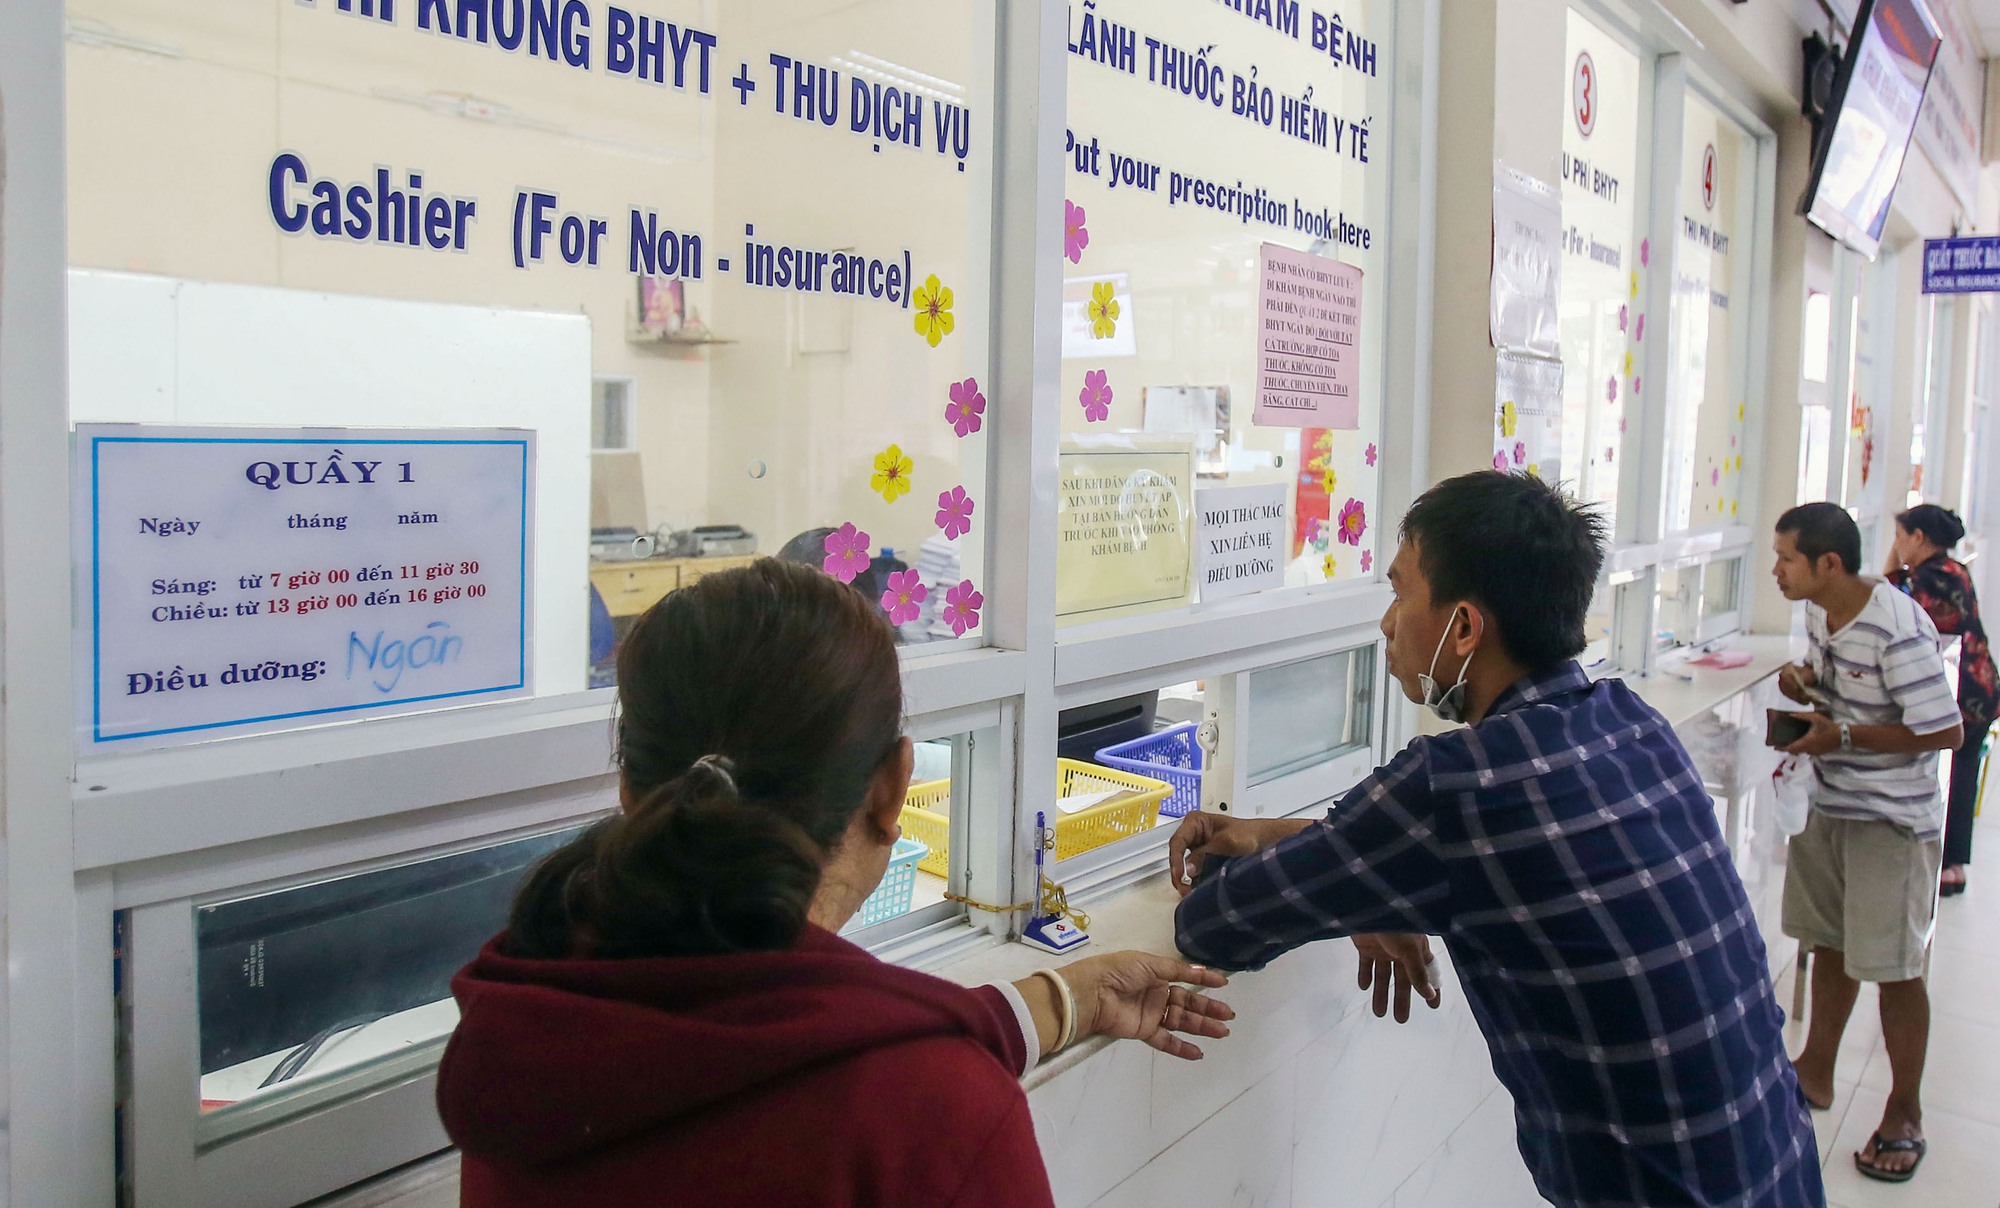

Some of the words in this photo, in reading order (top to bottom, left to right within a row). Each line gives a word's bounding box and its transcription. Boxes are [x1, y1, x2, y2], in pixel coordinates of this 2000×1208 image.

[1312, 11, 1376, 77] BỆNH
[608, 6, 717, 93] BHYT
[733, 64, 755, 105] +
[770, 53, 838, 126] THU
[851, 77, 922, 153] DỊCH
[934, 100, 969, 172] VỤ
[1068, 0, 1136, 75] LÃNH
[1145, 37, 1224, 107] THUỐC
[1232, 65, 1273, 127] BẢO
[1281, 86, 1327, 148] HIỂM
[1334, 116, 1344, 153] Y
[1350, 116, 1372, 164] TẾ
[1580, 64, 1591, 125] 3
[1573, 157, 1590, 191] PHÍ
[1593, 167, 1619, 204] BHYT
[1705, 155, 1712, 202] 4
[1109, 153, 1160, 192] your
[1170, 171, 1288, 227] prescription
[1294, 199, 1335, 240] book
[1338, 213, 1371, 250] here
[269, 153, 475, 249] Cashier
[513, 192, 606, 268] (For
[630, 209, 701, 279] Non
[746, 223, 911, 309] insurance)
[1684, 216, 1697, 241] THU
[1712, 231, 1729, 256] BHYT
[1266, 318, 1285, 331] BHYT
[246, 449, 381, 490] QUẦY
[398, 462, 415, 484] 1
[1063, 479, 1081, 490] SAU
[1085, 478, 1102, 490] KHI
[1069, 495, 1086, 507] XIN
[1073, 512, 1089, 526] TẠI
[1204, 510, 1229, 528] MỌI
[1232, 503, 1260, 522] THẮC
[1261, 500, 1284, 519] MẮC
[139, 517, 200, 536] Ngày
[288, 512, 348, 531] tháng
[398, 511, 438, 525] năm
[1064, 525, 1099, 541] TRƯỚC
[1101, 527, 1118, 538] KHI
[1211, 538, 1231, 554] XIN
[1233, 531, 1255, 551] LIÊN
[1259, 530, 1272, 549] HỆ
[1091, 539, 1121, 556] KHÁM
[1124, 540, 1147, 555] BỆH
[152, 575, 217, 598] Sáng:
[239, 574, 263, 590] từ
[270, 573, 281, 588] 7
[288, 570, 321, 591] giờ
[328, 569, 350, 584] 00
[356, 563, 393, 583] đến
[400, 565, 419, 580] 11
[426, 562, 454, 582] giờ
[460, 561, 479, 576] 30
[1208, 563, 1232, 584] ĐIỀU
[1236, 558, 1274, 578] DƯỠNG
[152, 601, 228, 623] Chiều:
[236, 599, 260, 616] từ
[268, 599, 290, 614] 13
[297, 595, 329, 616] giờ
[336, 594, 358, 609] 00
[364, 588, 401, 607] đến
[407, 588, 428, 603] 16
[434, 586, 462, 605] giờ
[467, 584, 486, 599] 00
[127, 665, 209, 696] Điều
[221, 659, 327, 687] dưỡng:
